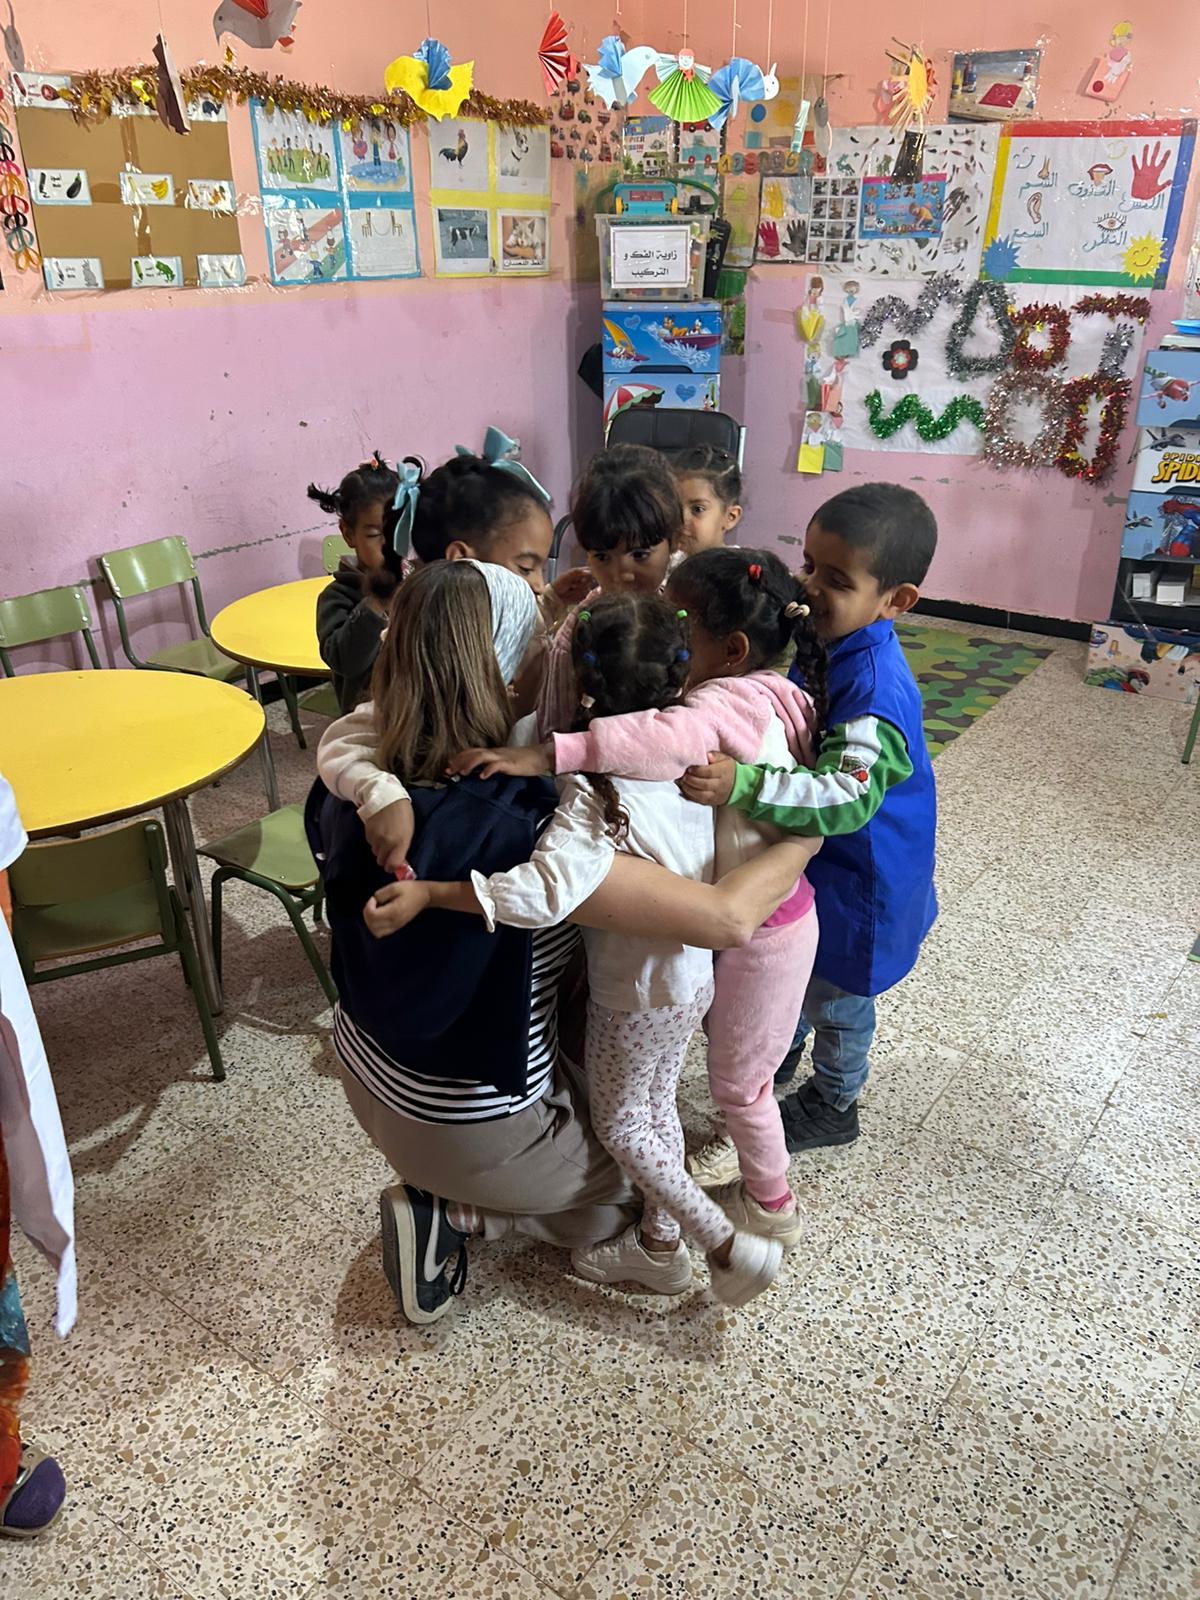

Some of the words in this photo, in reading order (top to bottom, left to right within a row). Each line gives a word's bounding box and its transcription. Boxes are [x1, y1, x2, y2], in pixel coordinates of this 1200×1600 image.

[623, 252, 629, 261] و
[630, 249, 654, 259] الفك
[656, 249, 678, 261] زاوية
[631, 267, 669, 278] التركيب
